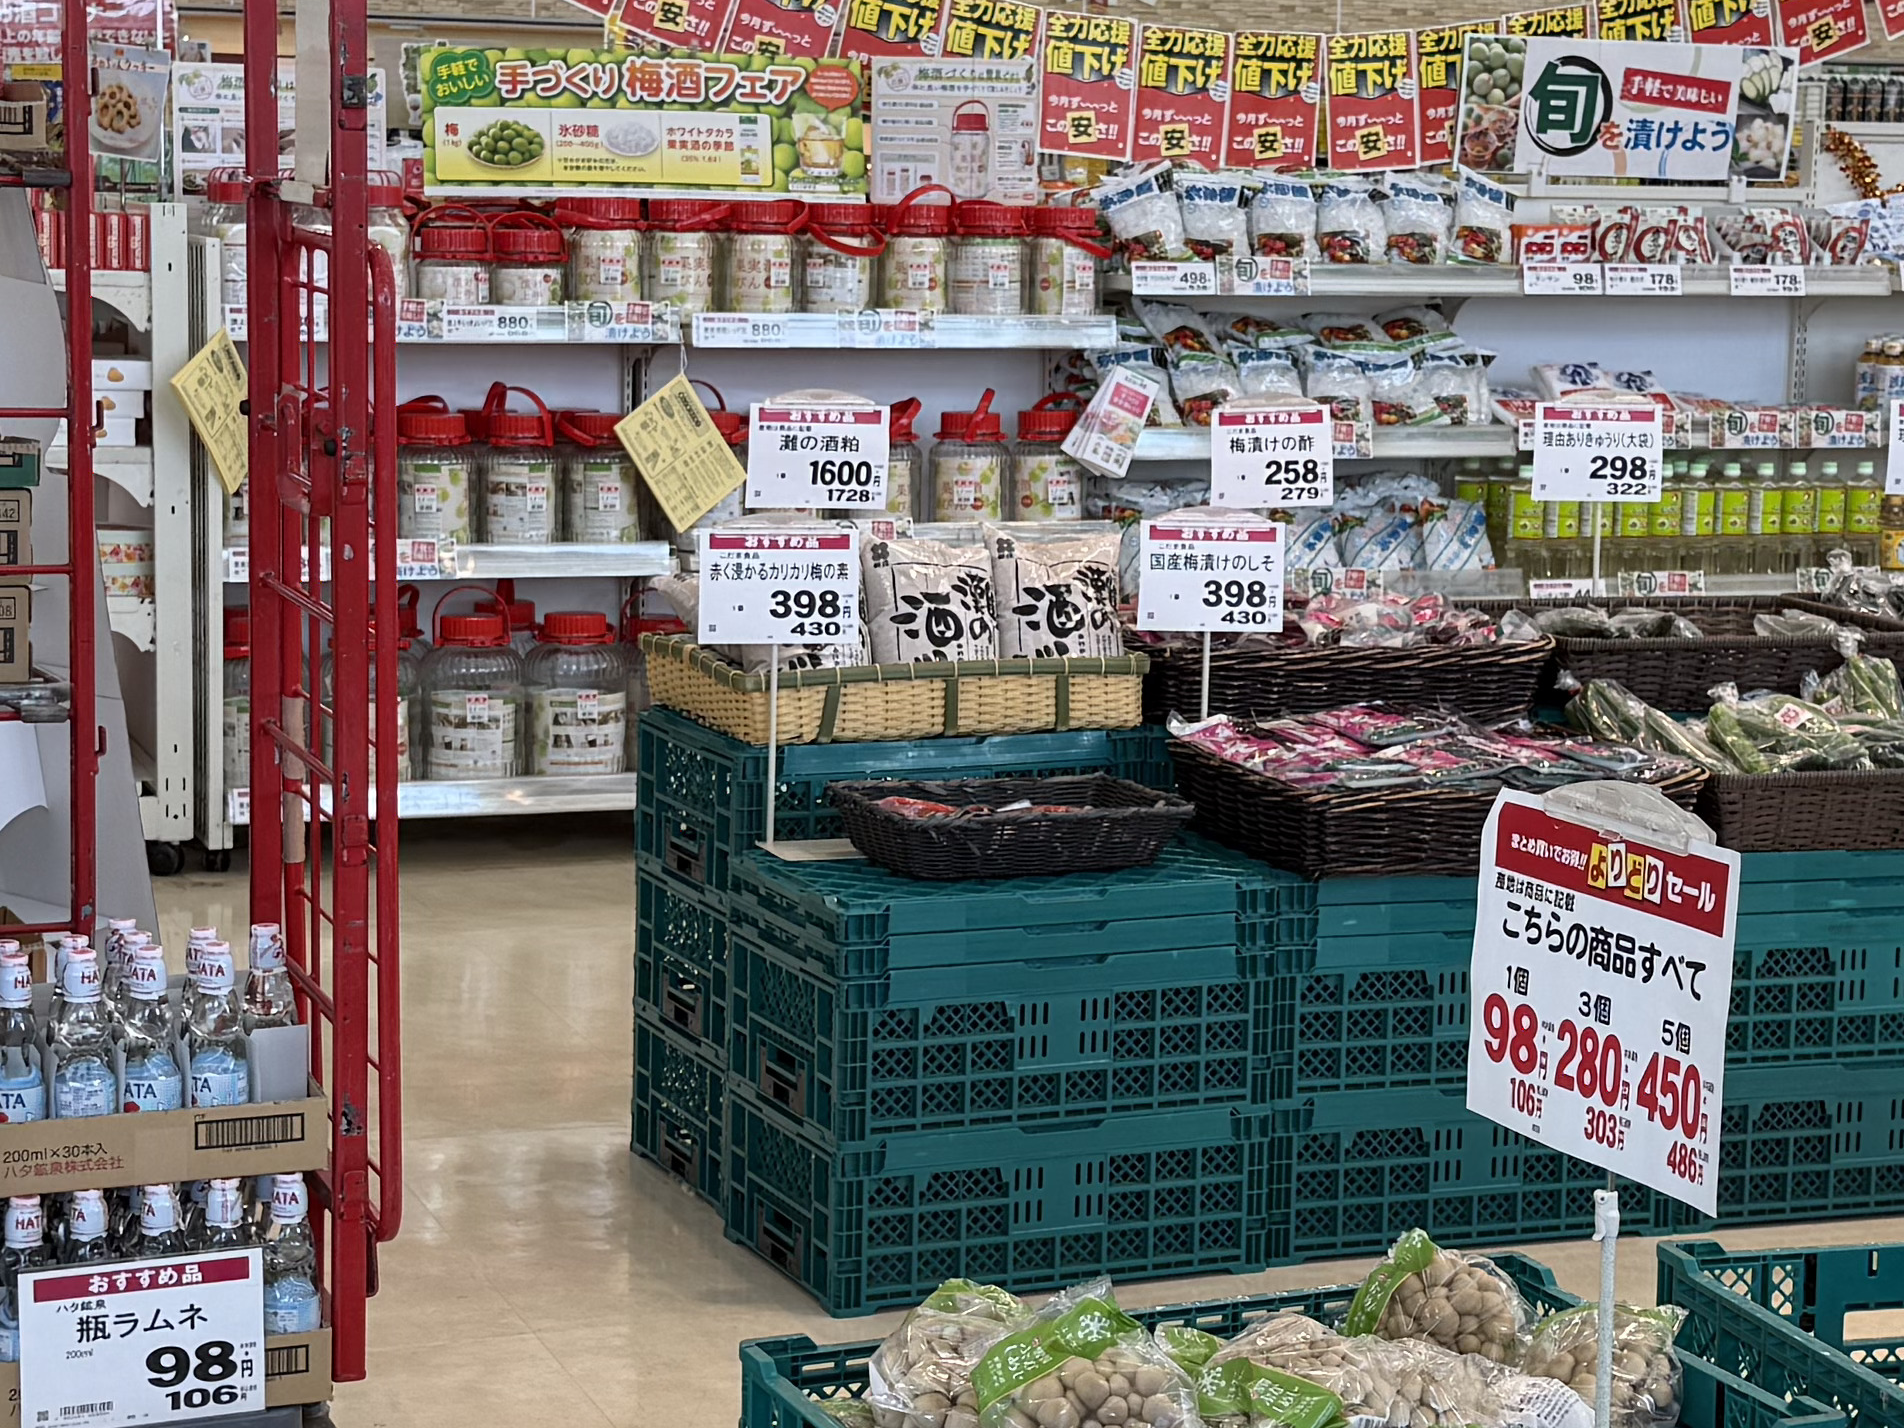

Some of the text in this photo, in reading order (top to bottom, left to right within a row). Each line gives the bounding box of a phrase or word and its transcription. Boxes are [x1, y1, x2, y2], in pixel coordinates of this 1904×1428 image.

[436, 58, 480, 82] 手軽で
[435, 78, 491, 99] おいしい
[496, 61, 620, 102] 手づくり
[624, 60, 806, 105] 梅酒フェア
[1629, 74, 1724, 106] 手軽で美味しい
[445, 121, 735, 140] 梅 氷砂糖 ホワイトタカラ
[497, 315, 783, 339] 880 880
[778, 434, 860, 453] 灘の酒粕
[1229, 436, 1316, 454] 梅漬けの酢
[1281, 487, 1320, 500] 279
[709, 562, 849, 582] 赤く浸かるカリカリ梅の素
[1150, 553, 1275, 572] 国産梅漬けのしそ
[790, 621, 841, 636] 430
[1221, 611, 1266, 625] 430
[1502, 900, 1707, 1002] こちらの商品すべて
[1506, 965, 1691, 1055] 1個 3個 5個
[3, 1143, 108, 1164] 200ml×30本入
[88, 1264, 203, 1294] おすすめ品
[76, 1304, 209, 1343] 瓶ラムネ
